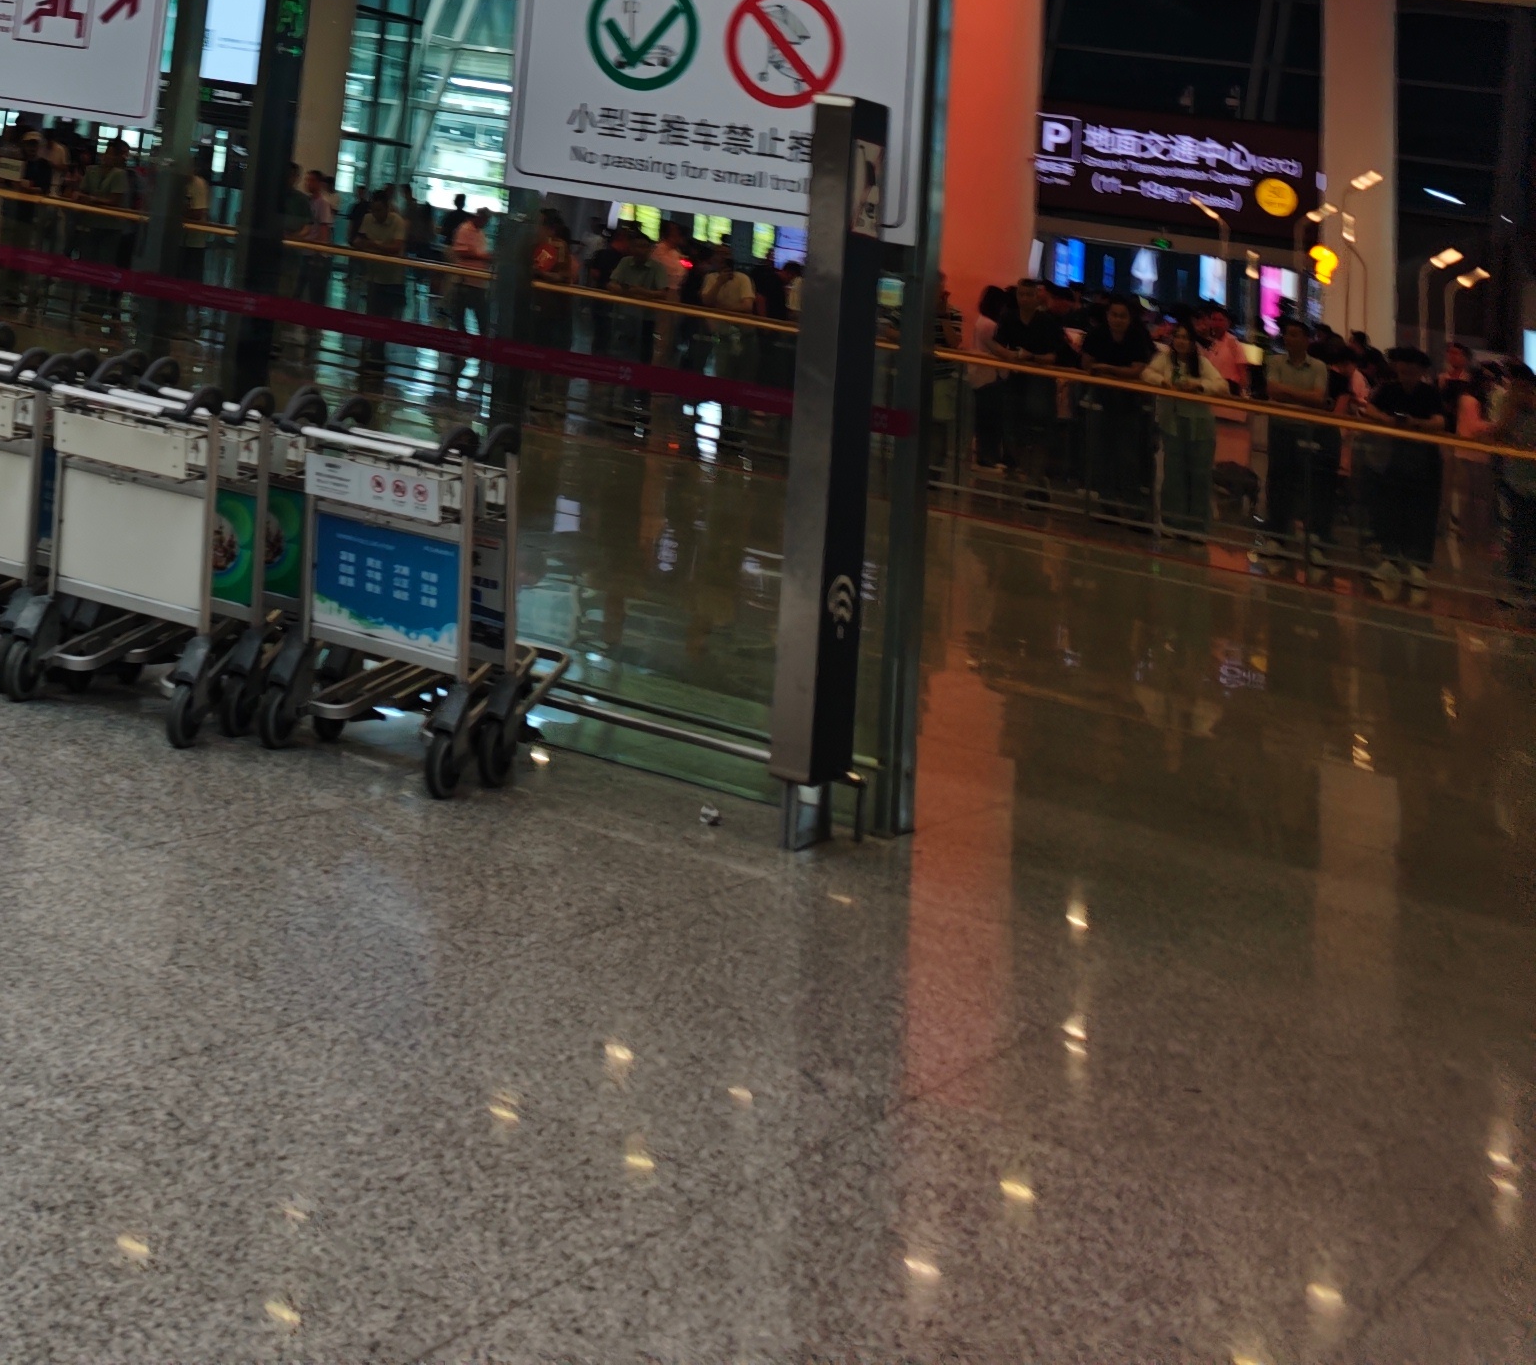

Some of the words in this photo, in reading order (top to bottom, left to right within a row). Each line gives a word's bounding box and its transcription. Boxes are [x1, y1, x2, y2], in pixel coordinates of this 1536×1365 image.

[1042, 120, 1072, 153] P
[569, 145, 597, 166] No
[601, 154, 678, 180] passing
[680, 159, 709, 180] for
[712, 166, 769, 190] small
